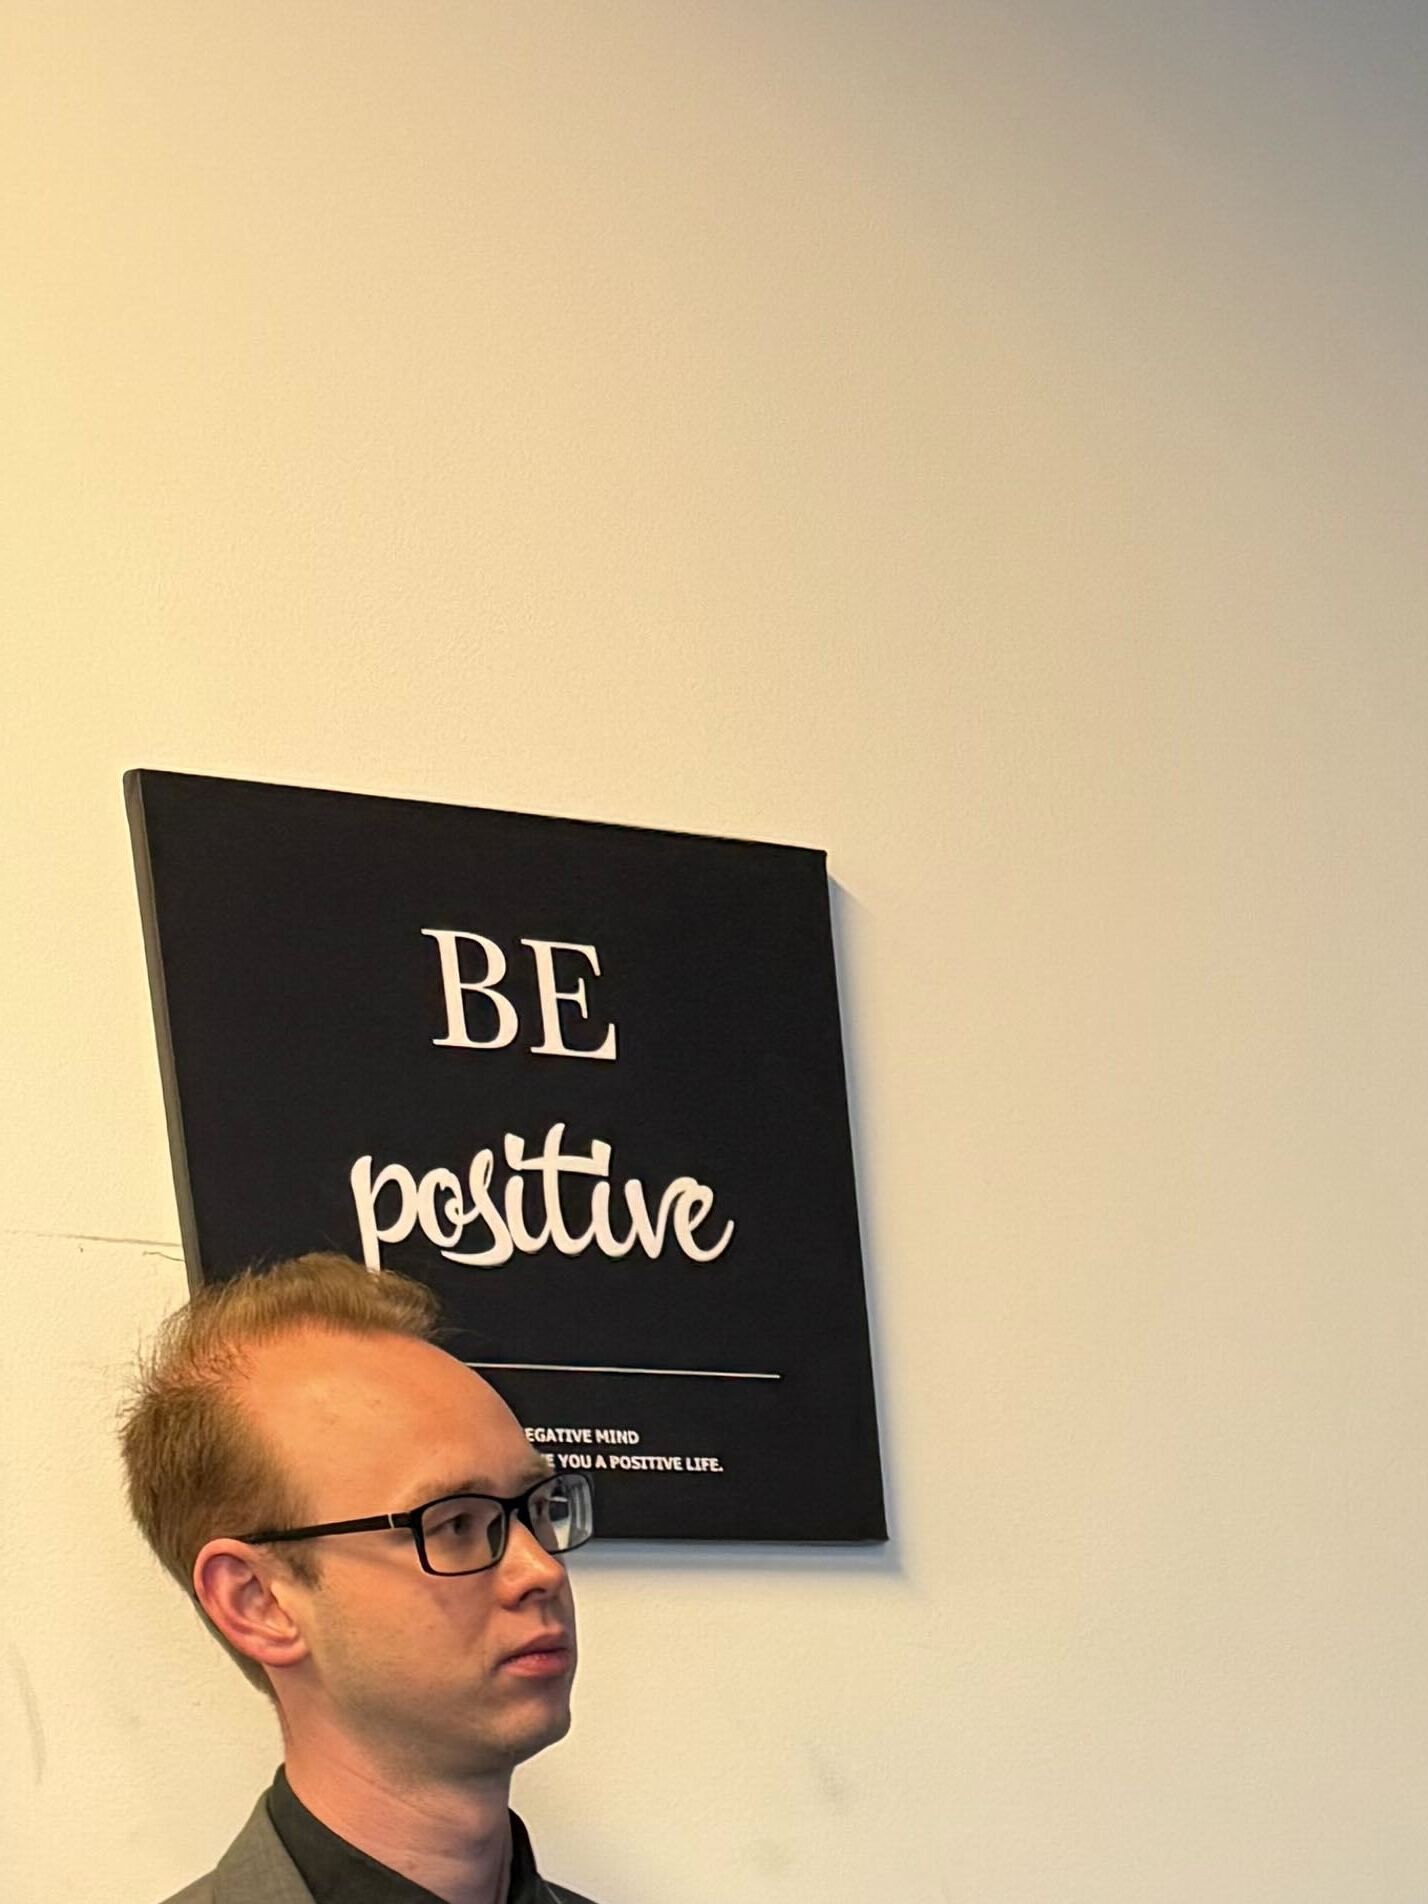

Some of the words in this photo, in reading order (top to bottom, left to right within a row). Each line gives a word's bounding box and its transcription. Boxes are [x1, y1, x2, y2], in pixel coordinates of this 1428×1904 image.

[420, 928, 618, 1060] BE
[350, 1122, 735, 1271] positive
[524, 1427, 593, 1443] EGATIVE
[595, 1429, 640, 1445] MIND
[557, 1453, 592, 1469] YOU
[595, 1454, 607, 1469] A
[609, 1455, 684, 1471] POSITIVE
[685, 1457, 724, 1472] LIFE.
